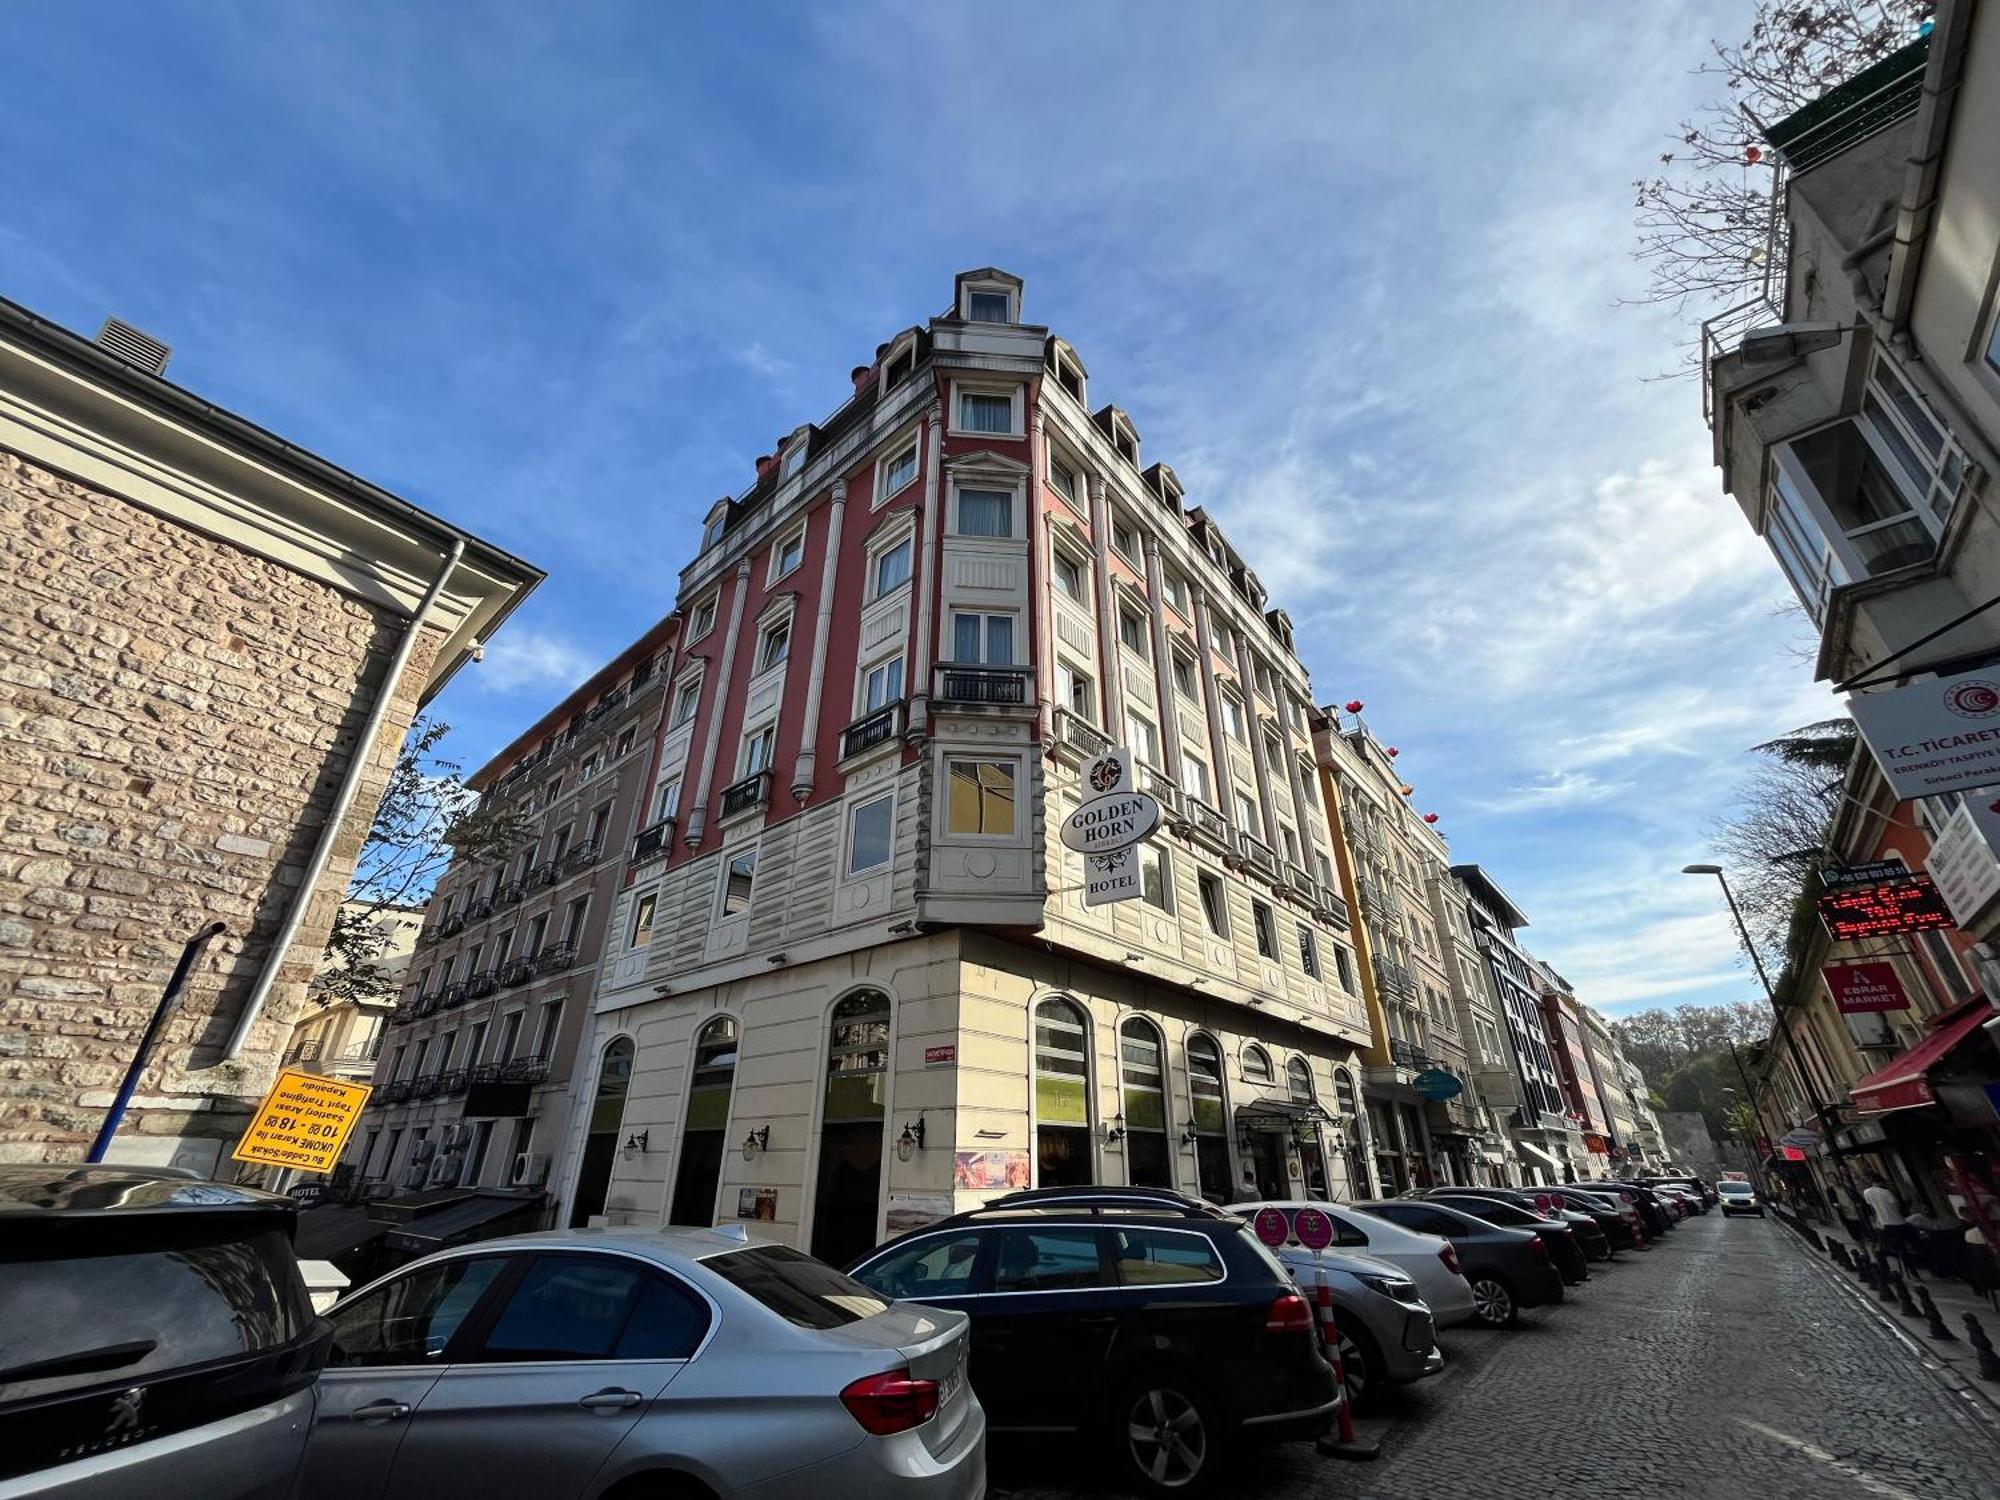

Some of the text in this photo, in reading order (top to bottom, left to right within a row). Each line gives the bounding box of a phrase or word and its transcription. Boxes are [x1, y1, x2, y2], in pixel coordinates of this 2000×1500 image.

[1884, 728, 2000, 759] T.C. TİCARET
[1894, 759, 1946, 774] ERENKÖY
[1923, 771, 1963, 785] Sirkeci
[1072, 798, 1144, 829] GOLDEN
[1085, 818, 1135, 843] HORN
[1090, 875, 1136, 894] HOTEL
[1843, 985, 1888, 995] EBRAR
[1842, 994, 1897, 1006] MARKET
[276, 1103, 303, 1115] Arası
[279, 1117, 297, 1132] 18
[322, 1125, 339, 1138] 10
[299, 1138, 334, 1153] UKOME
[313, 1155, 325, 1165] Bu
[292, 1187, 320, 1197] HOTEL
